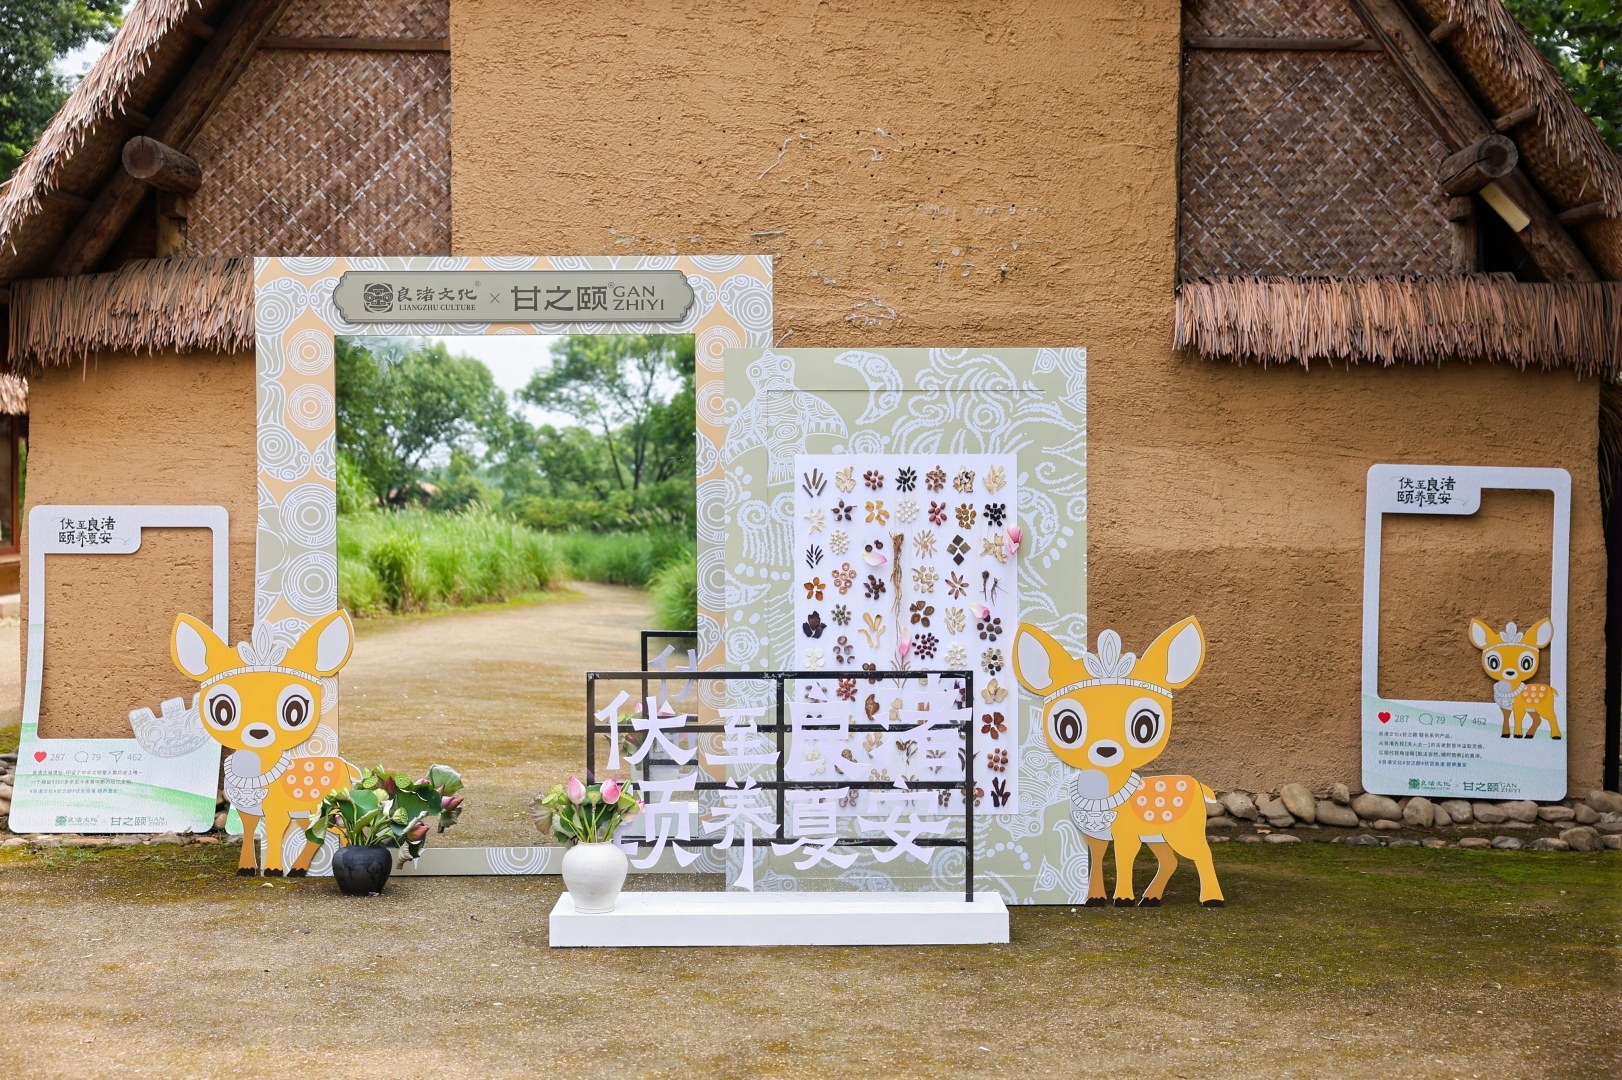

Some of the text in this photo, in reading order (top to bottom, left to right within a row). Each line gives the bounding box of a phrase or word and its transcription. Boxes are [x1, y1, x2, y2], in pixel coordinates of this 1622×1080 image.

[397, 286, 477, 302] 良渚文化
[511, 286, 608, 311] 甘之颐
[613, 286, 655, 298] GAN
[613, 299, 665, 311] ZHIYI
[1399, 476, 1456, 491] 伏至良渚
[1397, 490, 1452, 507] 颐养夏安
[59, 516, 116, 532] 伏至良渚
[58, 530, 113, 547] 颐养夏安
[1394, 714, 1487, 726] 287 79 462
[50, 753, 142, 762] 287 79 462
[1463, 781, 1499, 792] 甘之颐
[111, 817, 147, 826] 甘之颐
